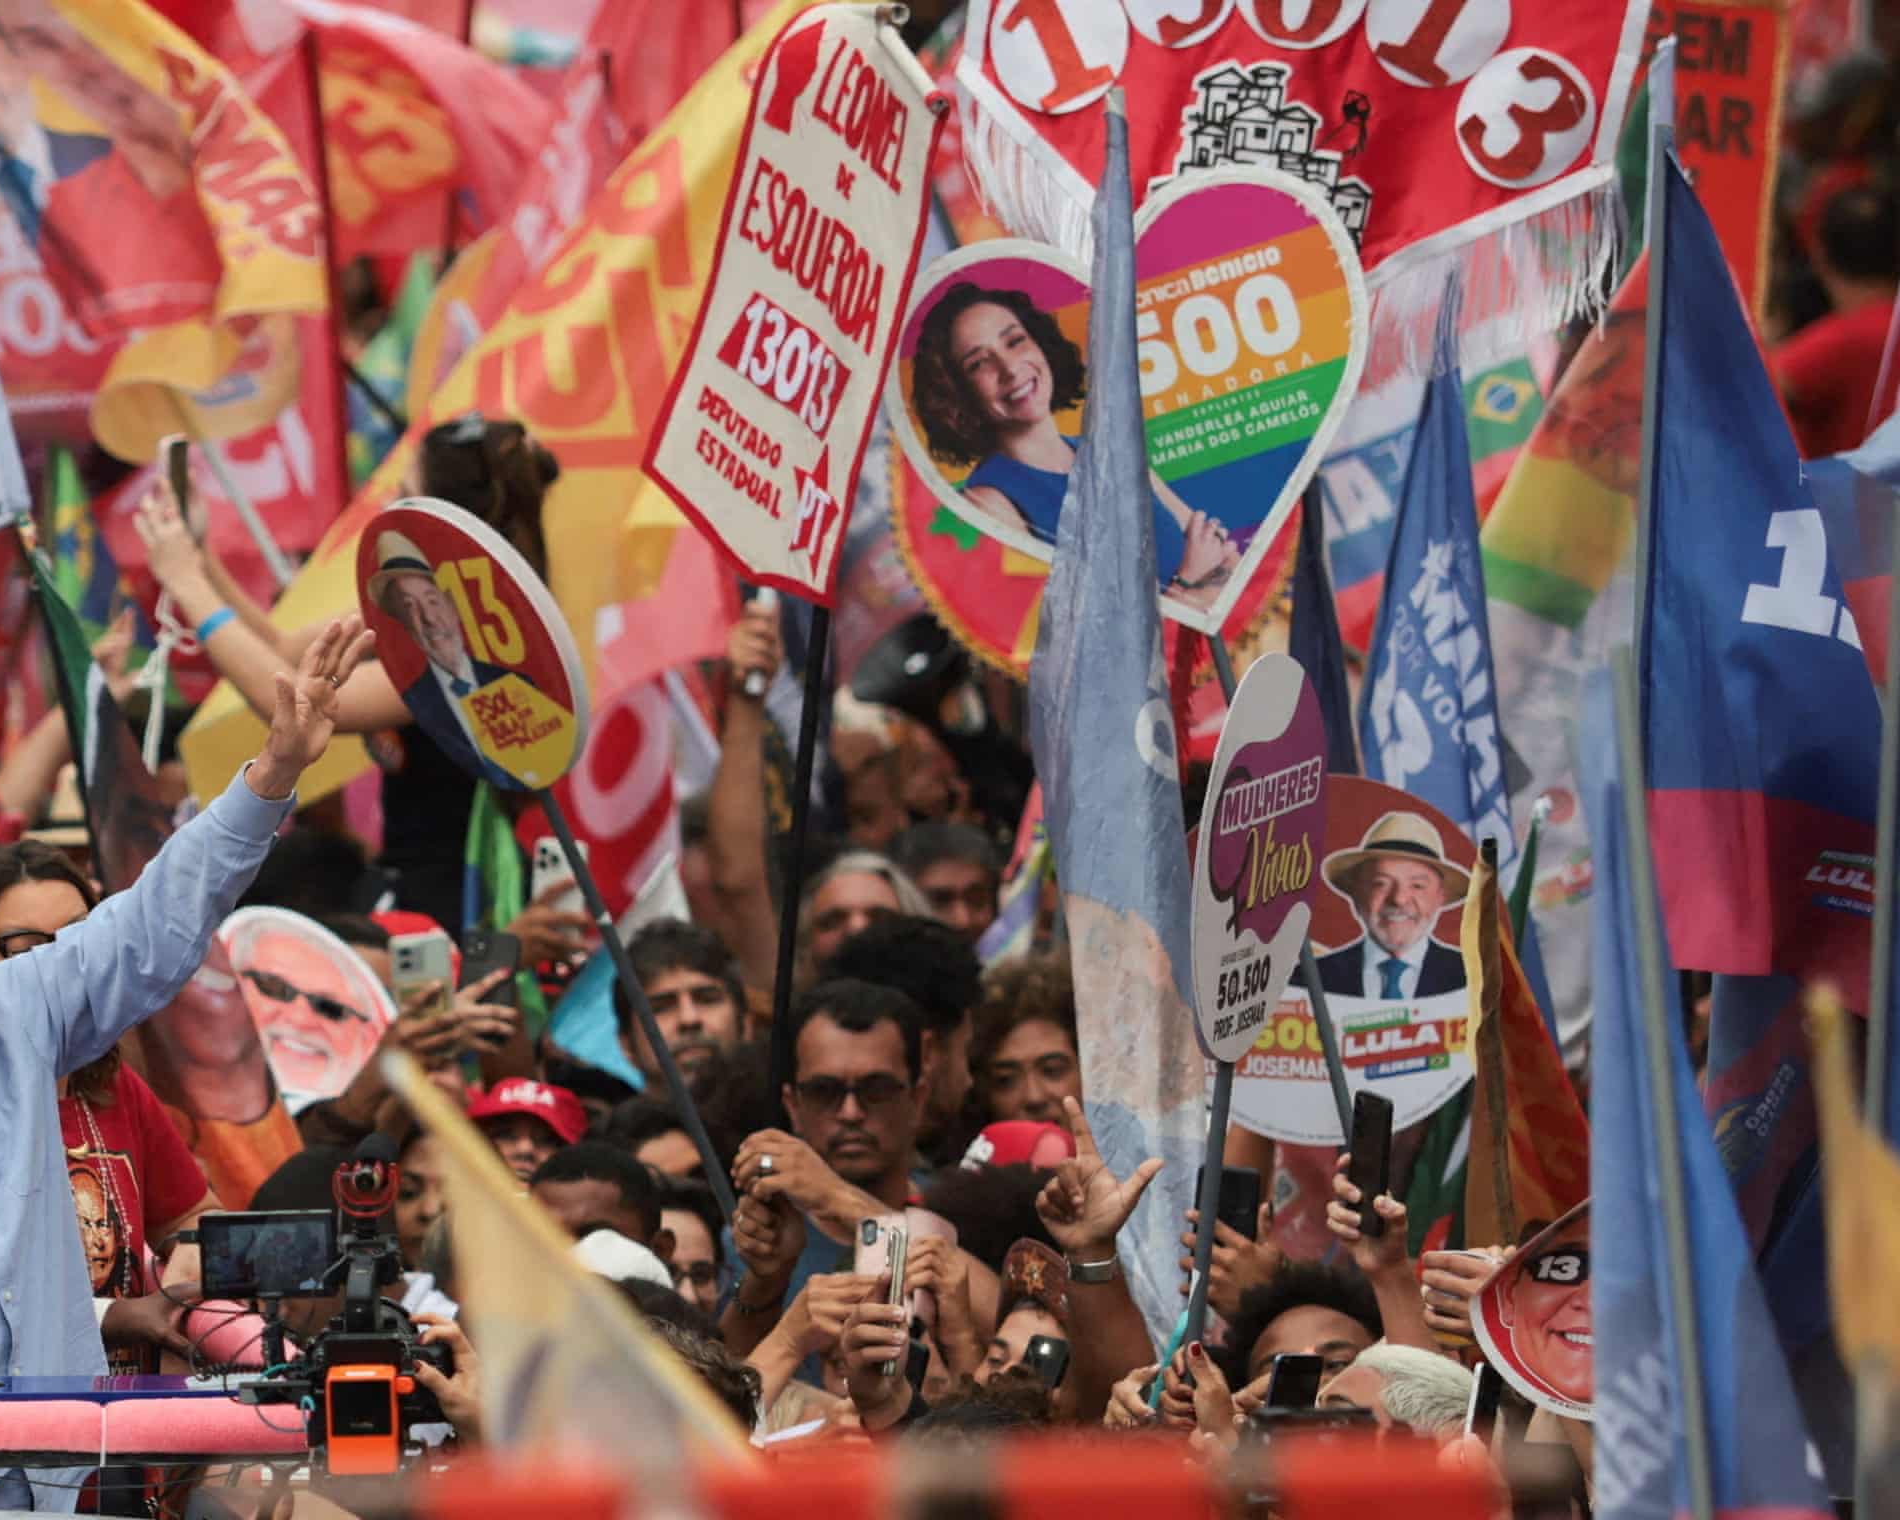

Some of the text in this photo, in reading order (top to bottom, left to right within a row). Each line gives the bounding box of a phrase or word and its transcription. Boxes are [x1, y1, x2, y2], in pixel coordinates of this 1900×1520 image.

[812, 36, 908, 195] LEONEL
[835, 161, 856, 201] DE
[739, 156, 884, 356] ESQUERDA
[737, 299, 837, 434] 13013
[697, 384, 783, 470] DEPUTADO
[1150, 403, 1321, 467] MARIA DOS CAMELOS
[1153, 389, 1309, 449] VANDERLEA AGUIAR
[696, 426, 782, 521] ESTADUAL
[791, 474, 832, 556] PT
[434, 556, 526, 666] 13
[1741, 508, 1864, 652] 1
[1219, 755, 1323, 837] MULHERES
[1246, 819, 1314, 910] Vivas
[1806, 864, 1877, 893] LUL
[1216, 953, 1271, 1011] 50.500
[1345, 1021, 1441, 1058] LULA
[1537, 1254, 1582, 1282] 13
